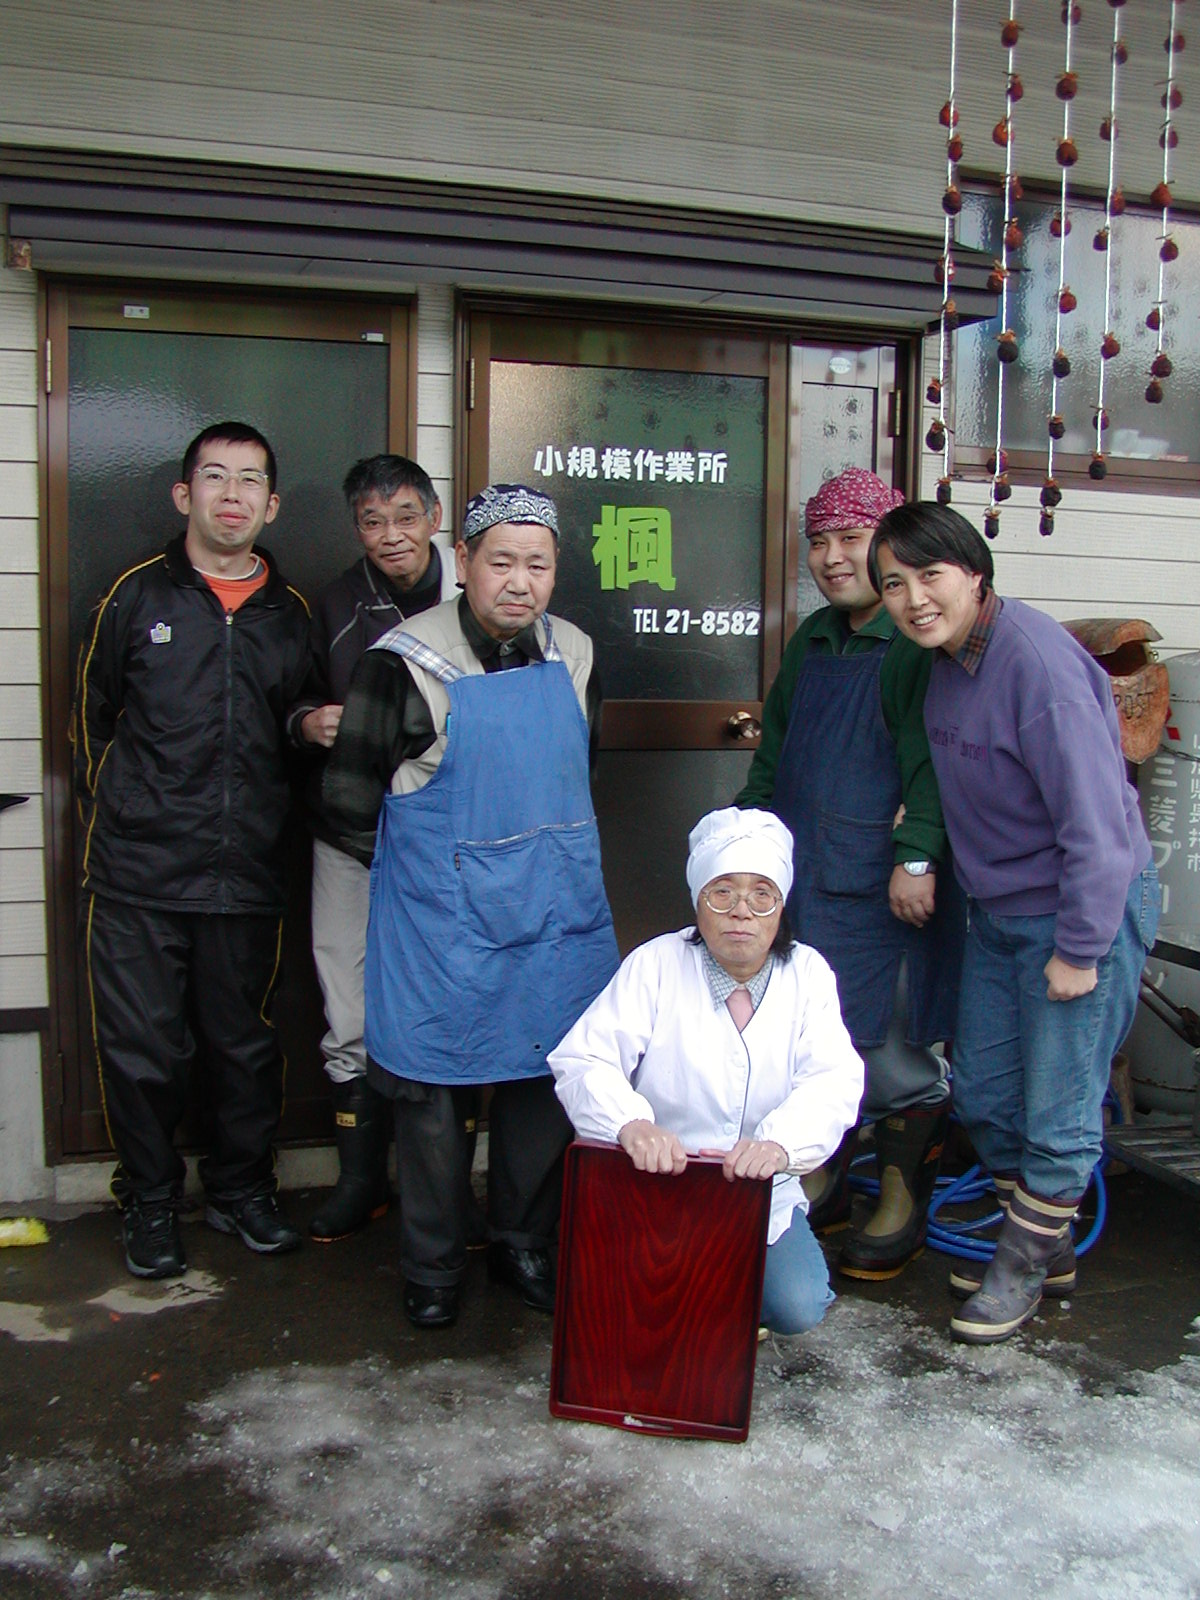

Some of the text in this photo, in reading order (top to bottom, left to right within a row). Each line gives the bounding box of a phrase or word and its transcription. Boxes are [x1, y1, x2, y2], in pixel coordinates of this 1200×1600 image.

[533, 445, 728, 484] 小規模作業所
[591, 505, 676, 591] 楓
[633, 608, 760, 636] TEL 21-8582
